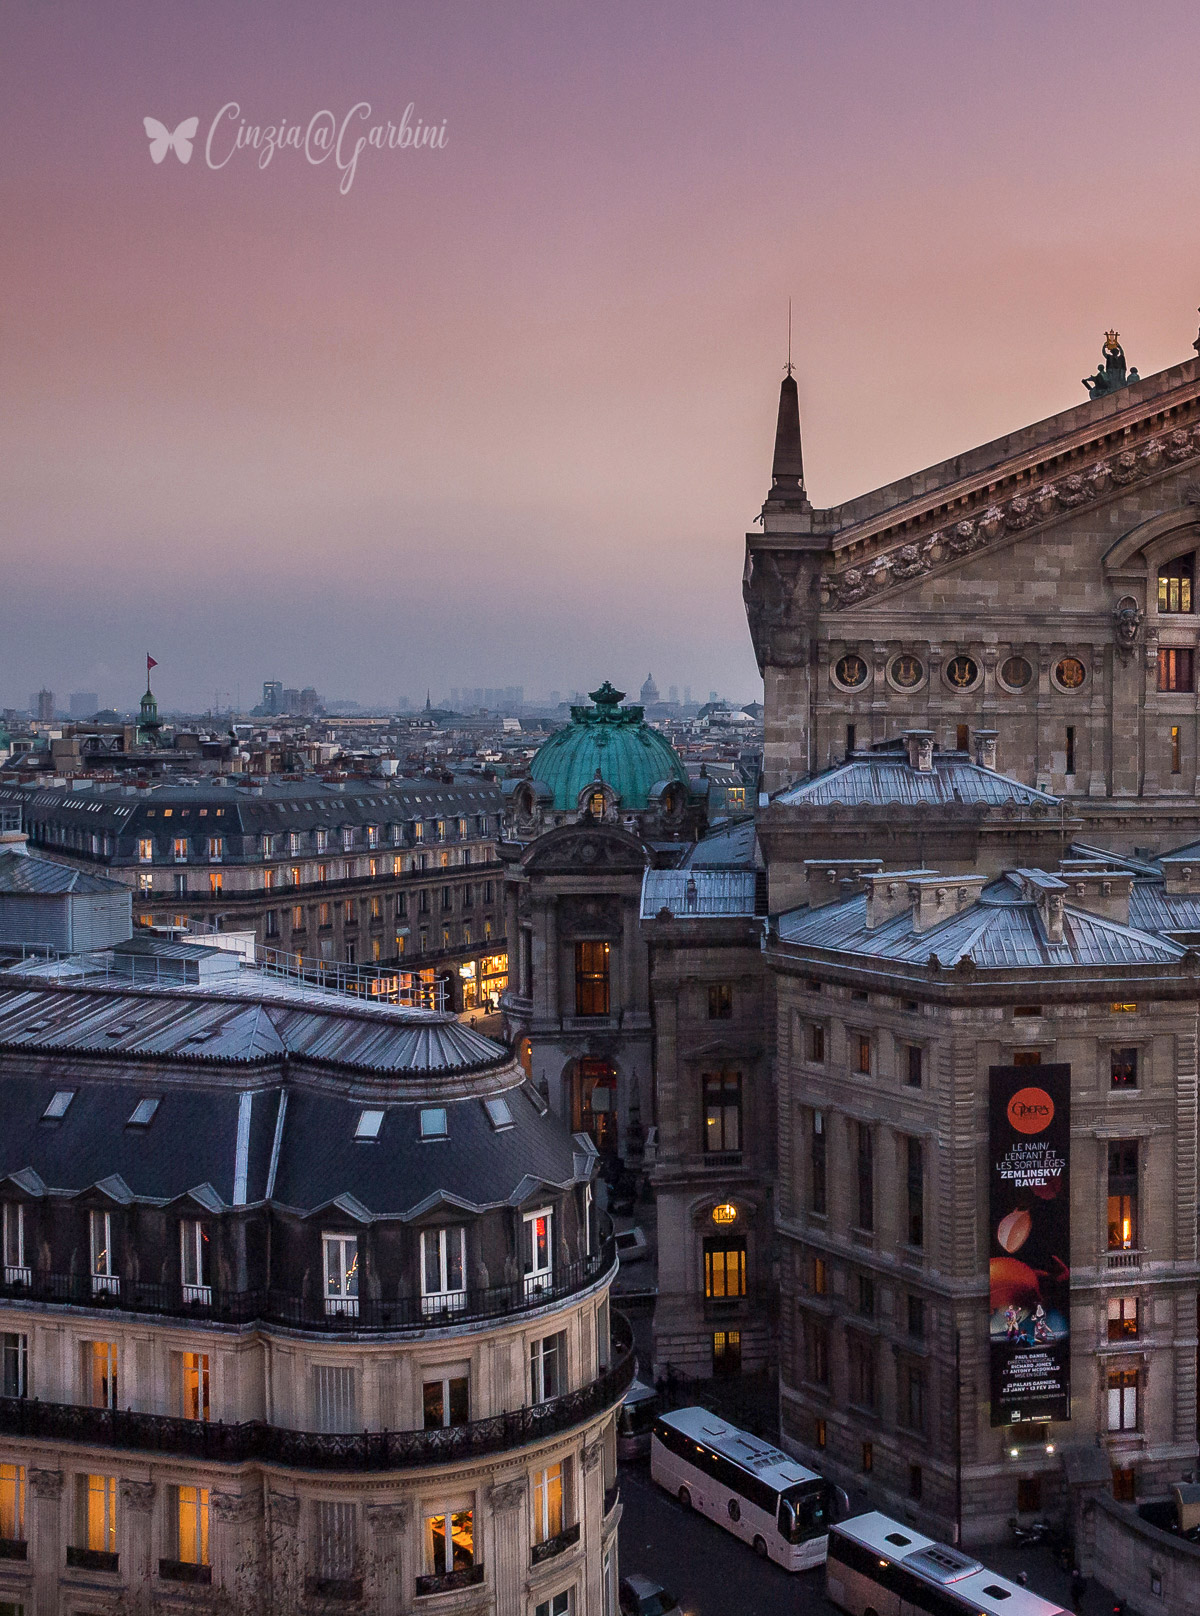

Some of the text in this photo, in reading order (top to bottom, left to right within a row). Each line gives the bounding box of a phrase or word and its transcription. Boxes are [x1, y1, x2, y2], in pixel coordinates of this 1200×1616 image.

[1012, 1142, 1049, 1151] LE NAIN/
[1005, 1150, 1056, 1161] L'ENFANT ET
[996, 1161, 1012, 1171] LES
[1000, 1168, 1062, 1179] ZEMLINSKY/
[1015, 1178, 1047, 1187] RAVEL
